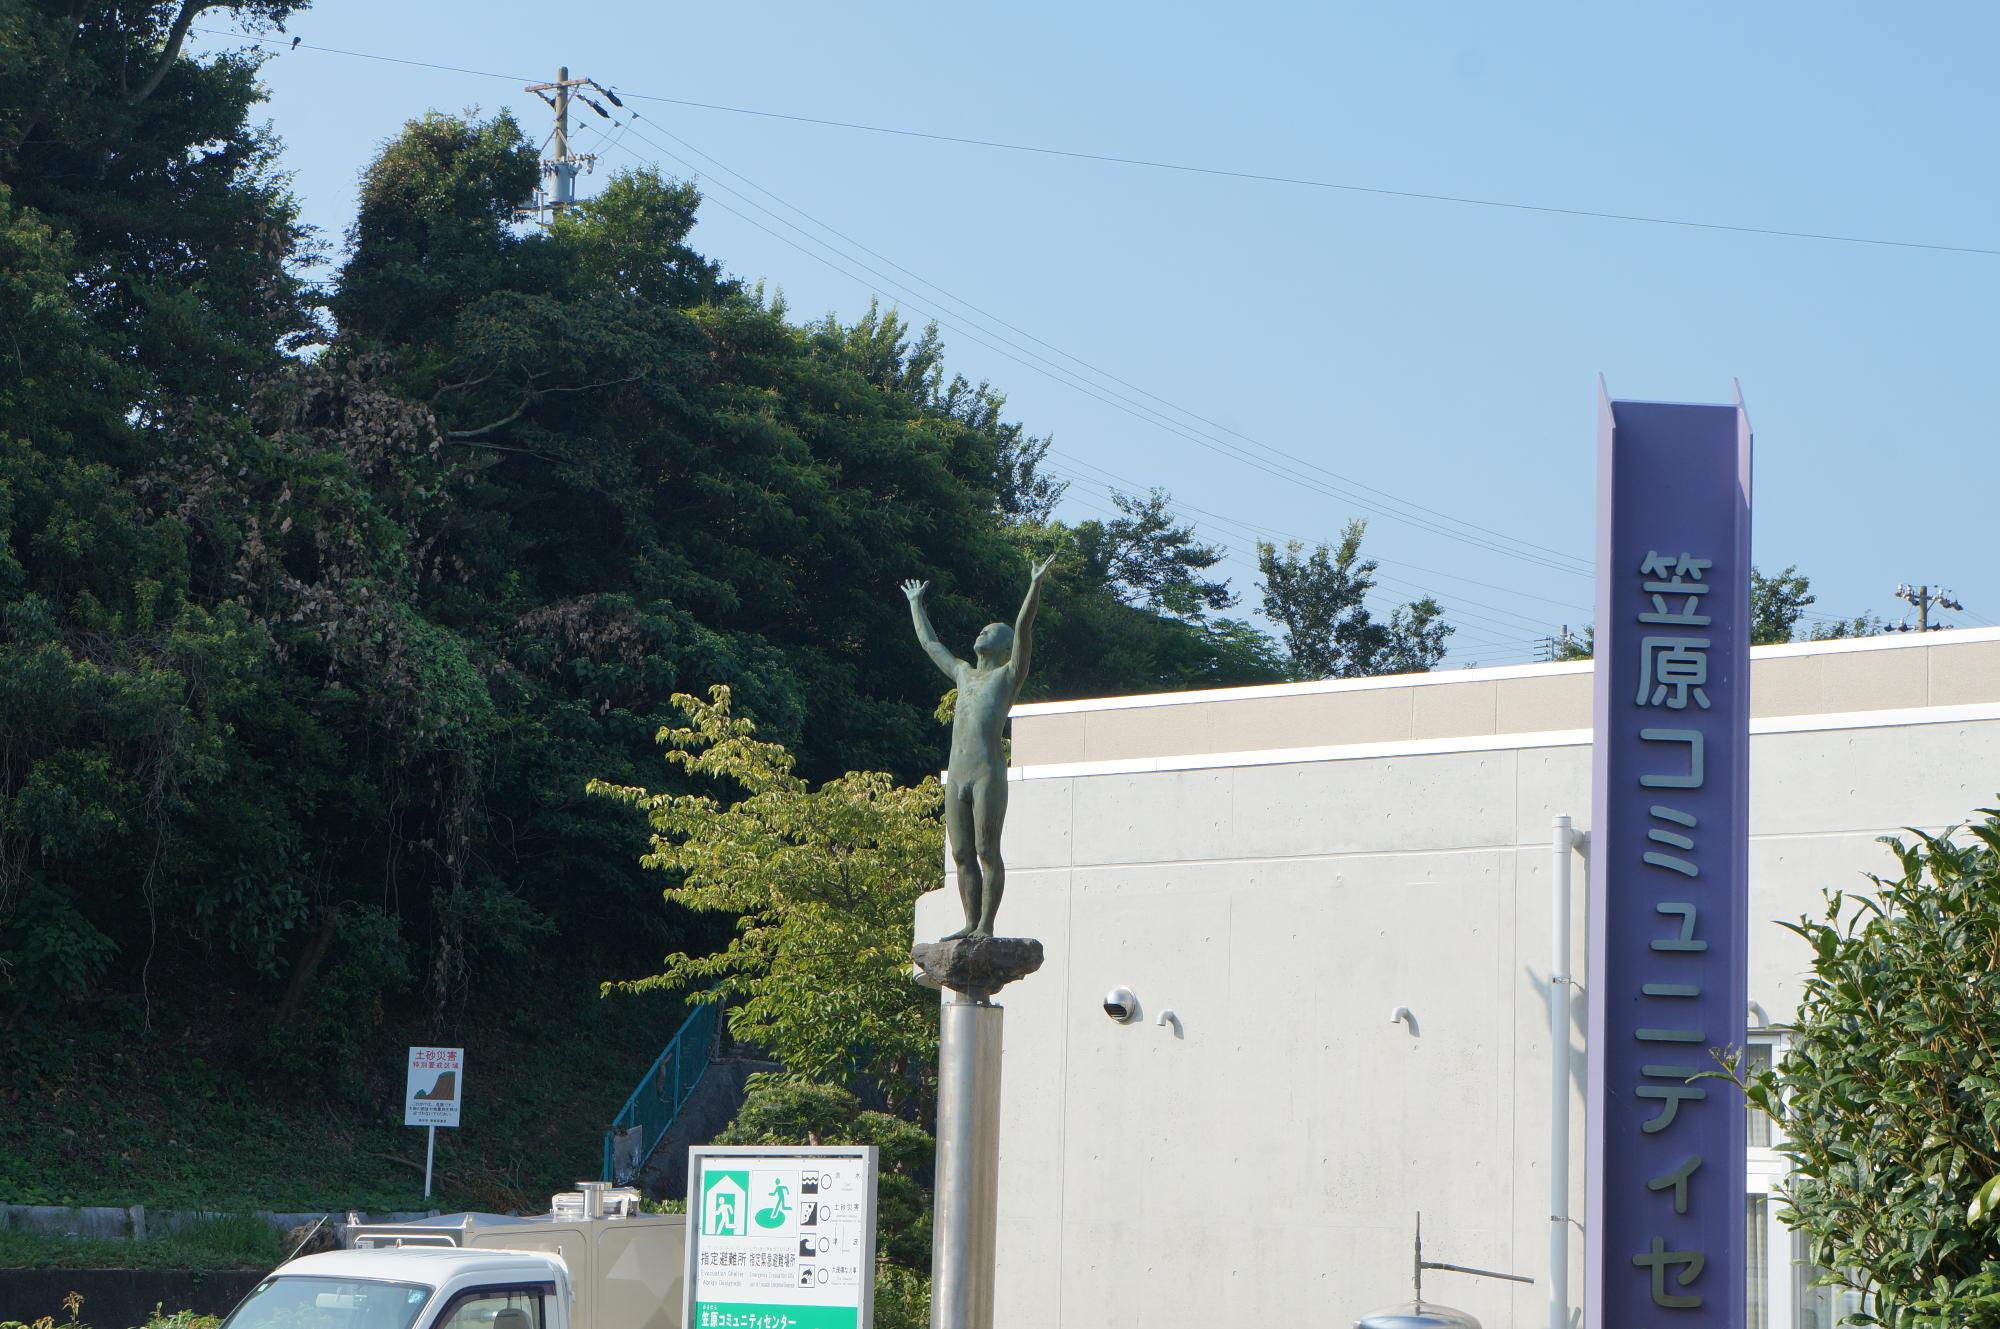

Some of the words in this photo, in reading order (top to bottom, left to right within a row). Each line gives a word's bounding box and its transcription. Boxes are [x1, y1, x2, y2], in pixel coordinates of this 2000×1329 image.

[1632, 550, 1713, 1309] 笠原コミュニティセ
[415, 1050, 457, 1061] 土砂災害
[413, 1061, 459, 1069] 特別警戒区域
[701, 1252, 747, 1267] 指定避難所
[750, 1253, 796, 1268] 指定緊急避難場所
[701, 1311, 797, 1329] 笠原コミュニティセンター
